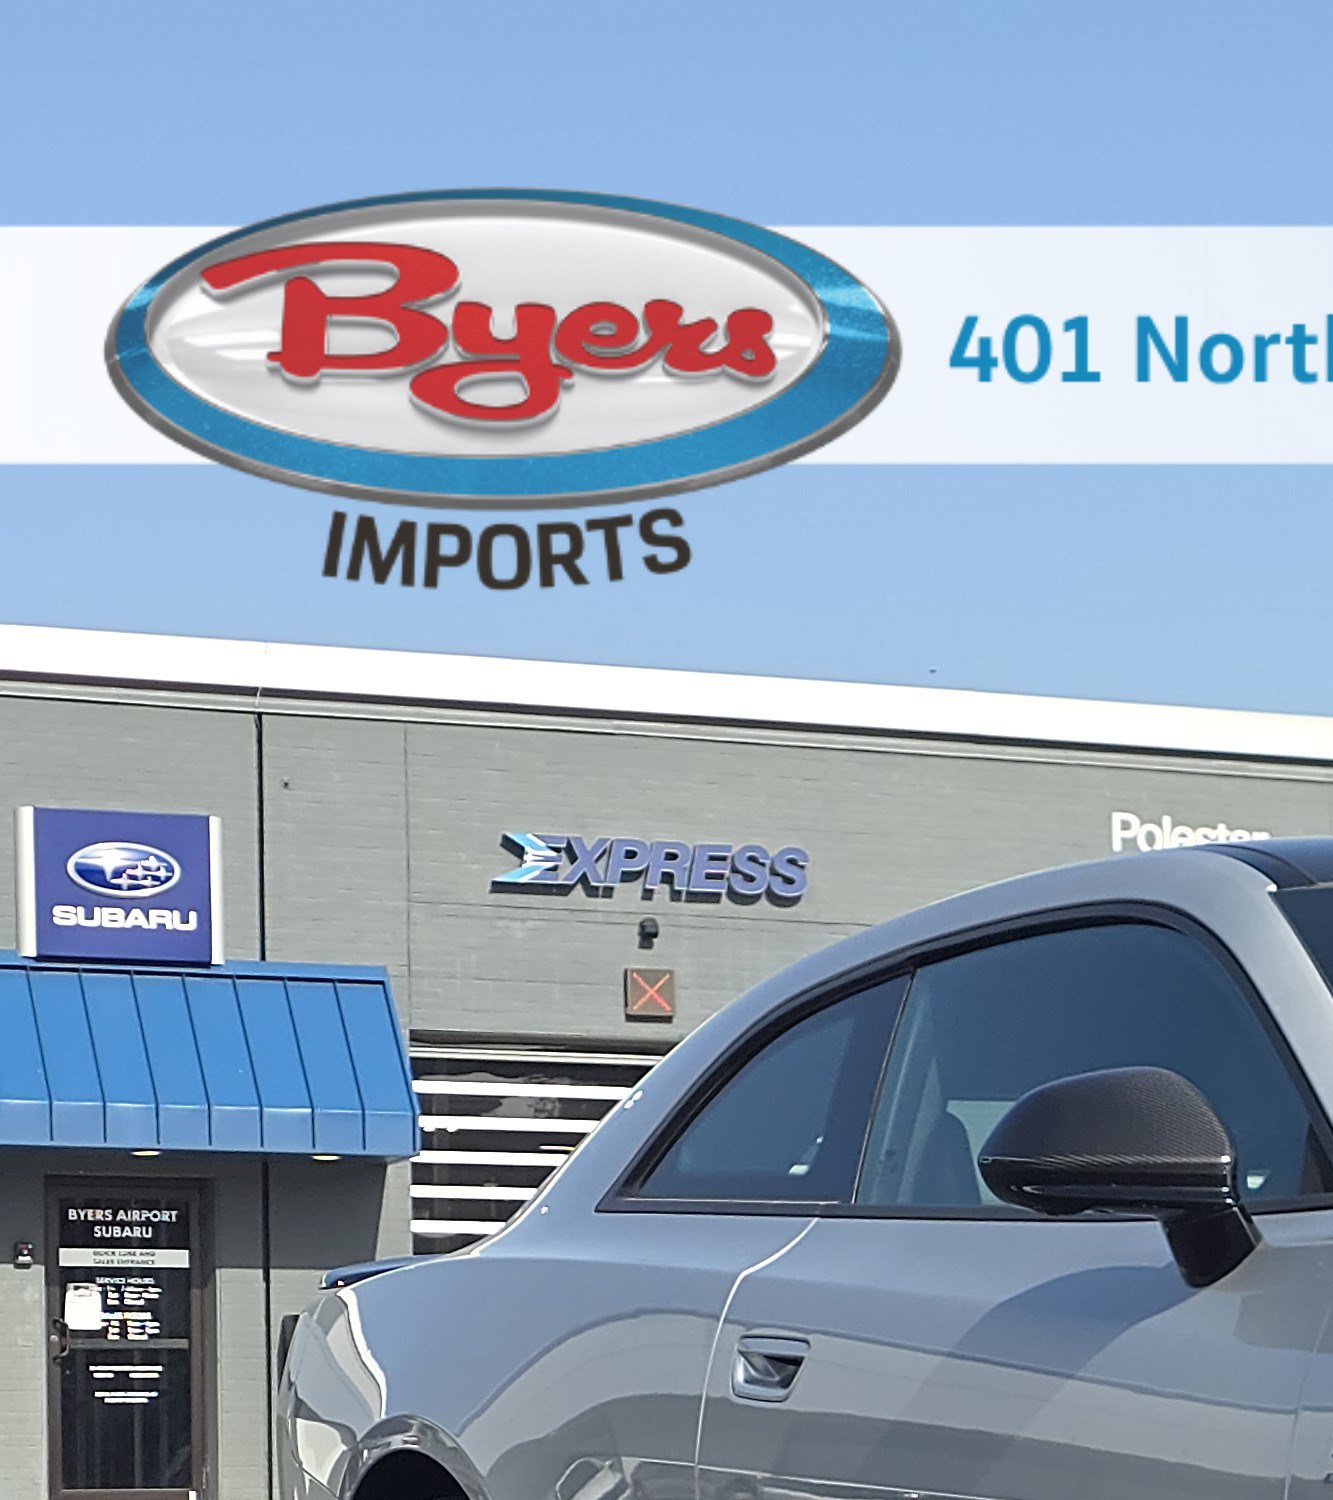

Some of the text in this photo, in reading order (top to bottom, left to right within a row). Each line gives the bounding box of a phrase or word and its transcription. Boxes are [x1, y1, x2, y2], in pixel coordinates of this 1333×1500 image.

[491, 832, 809, 900] EXPRESS
[51, 905, 198, 932] SUBARU
[68, 1208, 179, 1222] BYERS AIRPORT
[93, 1225, 153, 1238] SUBARU
